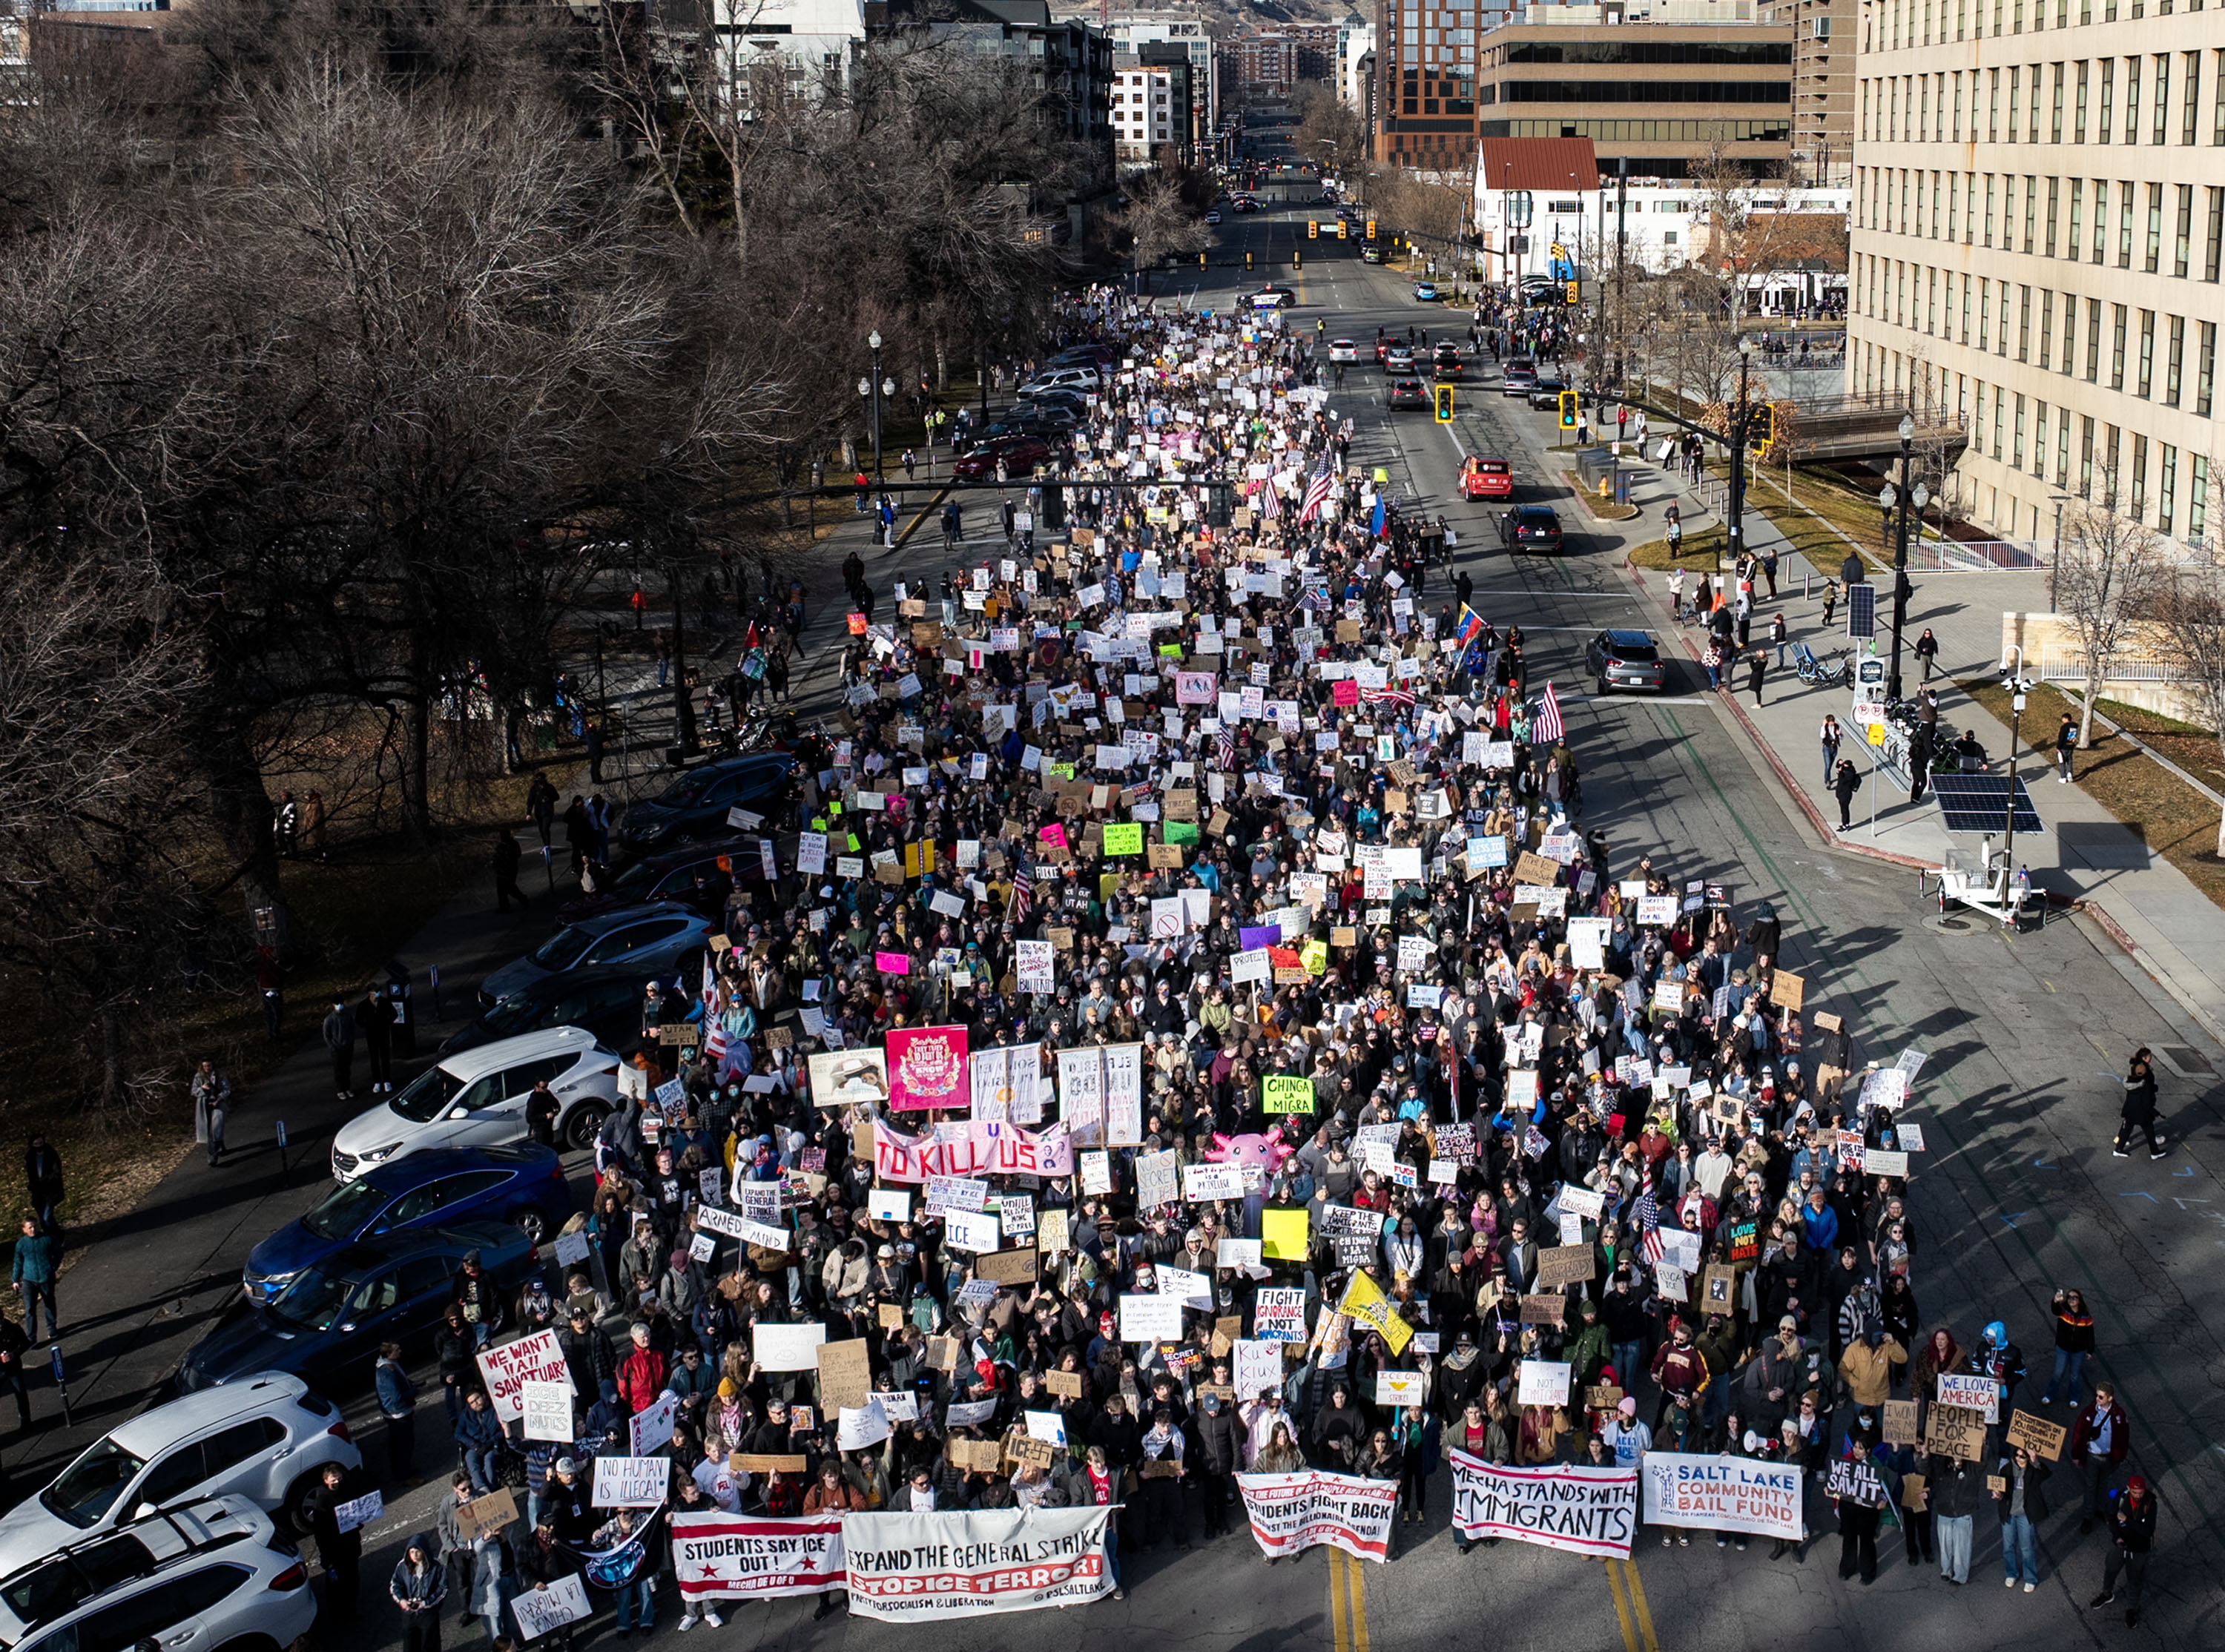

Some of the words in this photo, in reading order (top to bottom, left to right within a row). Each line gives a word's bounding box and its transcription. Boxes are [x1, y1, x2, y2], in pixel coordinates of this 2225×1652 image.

[1395, 770, 1412, 782] ICE
[1471, 844, 1491, 853] LESS
[1491, 842, 1504, 851] ICE
[802, 856, 819, 865] LAND
[1471, 855, 1489, 865] MORE
[1489, 853, 1506, 862] SNOW
[1293, 873, 1323, 882] ABOLISH
[1078, 889, 1090, 897] OUT
[1065, 899, 1089, 910] UTAH
[1021, 942, 1032, 951] the
[1400, 939, 1425, 950] ICE
[1019, 956, 1044, 967] ORANGE
[1233, 952, 1267, 966] PROTECT
[1399, 956, 1425, 969] KILLERS
[1020, 961, 1049, 974] MONARCH
[1019, 978, 1054, 992] BUTTERFLY
[664, 1025, 692, 1034] UTAH
[1268, 1078, 1310, 1093] CHINGA
[1273, 1100, 1310, 1113] MIGRA
[1361, 1126, 1377, 1135] ICE
[1385, 1126, 1396, 1134] IS
[1435, 1124, 1457, 1133] KEEP
[1527, 1128, 1544, 1143] MAGA
[1437, 1139, 1471, 1149] DEPORT
[877, 1140, 908, 1175] TO
[919, 1140, 985, 1177] KILL
[1000, 1138, 1037, 1171] US
[1437, 1149, 1452, 1157] THE
[1138, 1156, 1153, 1170] NO
[1844, 1156, 1862, 1167] YOU
[1138, 1168, 1176, 1186] SECRET
[1394, 1166, 1416, 1177] FUCK
[1394, 1175, 1415, 1186] ICE
[745, 1188, 765, 1196] EXPAND
[1139, 1186, 1176, 1205] POLICE
[745, 1195, 777, 1206] GENERAL
[1560, 1197, 1599, 1217] CRUSHED
[747, 1206, 776, 1216] STRIKE!
[1332, 1207, 1357, 1220] KEEP
[1358, 1210, 1377, 1222] THE
[699, 1206, 742, 1234] ARMED
[749, 1230, 781, 1248] MIND
[1016, 1222, 1033, 1231] FREE
[1327, 1216, 1378, 1231] IMMIGRANTS
[947, 1224, 969, 1245] ICE
[1731, 1223, 1756, 1239] LOVE
[1339, 1235, 1372, 1246] CHINGA
[1734, 1234, 1756, 1247] NOT
[1350, 1246, 1362, 1254] LA
[1541, 1243, 1593, 1263] ENOUGH
[1731, 1243, 1758, 1261] HATE
[1171, 1269, 1193, 1281] FUCK
[1540, 1258, 1594, 1281] ALREADY
[1658, 1269, 1684, 1284] FUCK
[1665, 1281, 1678, 1290] ICE
[1262, 1290, 1303, 1305] FIGHT
[1256, 1305, 1303, 1318] IGNORANCE
[1268, 1318, 1295, 1330] NOT
[486, 1349, 508, 1370] WE
[509, 1333, 551, 1359] WANT
[1161, 1346, 1175, 1354] NO
[1163, 1348, 1195, 1361] SECRET
[1238, 1343, 1260, 1363] Ku
[1167, 1356, 1200, 1368] POLICE
[1049, 1374, 1078, 1387] ABOLISH
[1380, 1372, 1401, 1380] ICE
[1405, 1372, 1423, 1381] OUT
[1537, 1378, 1555, 1388] NOT
[1055, 1384, 1072, 1393] ICE
[1942, 1377, 1959, 1390] WE
[1965, 1378, 1994, 1392] LOVE
[527, 1384, 560, 1401] ICE
[882, 1393, 906, 1404] HUMAN
[1523, 1388, 1567, 1402] IMMIGRANTS
[1585, 1387, 1607, 1400] FUCK
[1939, 1389, 1996, 1407] AMERICA
[528, 1401, 566, 1415] DEEZ
[1928, 1401, 1984, 1430] PEOPLE
[529, 1415, 568, 1432] NUTS
[1884, 1419, 1902, 1430] HATE
[1903, 1420, 1916, 1431] MY
[1935, 1422, 1968, 1443] FOR
[1616, 1435, 1638, 1447] MELT
[1928, 1438, 1971, 1458] PEACE
[602, 1461, 619, 1478] NO
[622, 1458, 663, 1478] HUMAN
[1830, 1458, 1852, 1477] WE
[1853, 1464, 1879, 1484] ALL
[1678, 1464, 1731, 1481] SALT
[1740, 1469, 1795, 1491] LAKE
[599, 1481, 611, 1500] IS
[620, 1479, 660, 1499] ILLEGAL
[1451, 1465, 1509, 1496] MECHA
[1512, 1480, 1586, 1504] STANDS
[1589, 1482, 1638, 1505] WITH
[1827, 1476, 1857, 1498] SAW
[1858, 1481, 1882, 1501] IT
[1256, 1488, 1268, 1499] THE
[1268, 1487, 1294, 1499] FUTURE
[1362, 1488, 1391, 1499] PLANET
[1677, 1481, 1796, 1506] COMMUNITY
[1245, 1498, 1308, 1519] STUDENTS
[1311, 1495, 1348, 1513] FIGHT
[1351, 1501, 1391, 1520] BACK
[1455, 1487, 1632, 1541] IMMIGRANTS
[1678, 1497, 1727, 1512] BAIL
[1736, 1499, 1794, 1522] FUND
[474, 1510, 510, 1533] MINN
[1282, 1520, 1296, 1530] THE
[1299, 1512, 1345, 1527] BILLIONAIRE
[1661, 1508, 1681, 1517] FONDO
[1716, 1512, 1756, 1523] COMUNITARIO
[685, 1538, 764, 1561] STUDENTS
[767, 1539, 797, 1555] SAY
[802, 1537, 826, 1554] ICE
[848, 1548, 911, 1572] EXPAND
[913, 1544, 949, 1569] THE
[953, 1542, 1033, 1569] GENERAL
[1037, 1527, 1101, 1559] STRIKE
[727, 1578, 757, 1590] MECHA
[757, 1578, 768, 1588] DE
[776, 1576, 787, 1587] OF
[788, 1576, 795, 1586] U
[852, 1576, 924, 1596] STOP
[924, 1574, 971, 1593] ICE
[975, 1556, 1101, 1593] TERROR!
[564, 1582, 581, 1601] LA
[889, 1599, 934, 1612] SOCIALISM
[935, 1599, 945, 1609] &
[944, 1598, 995, 1608] LIBERATION
[533, 1605, 575, 1633] CHINGA
